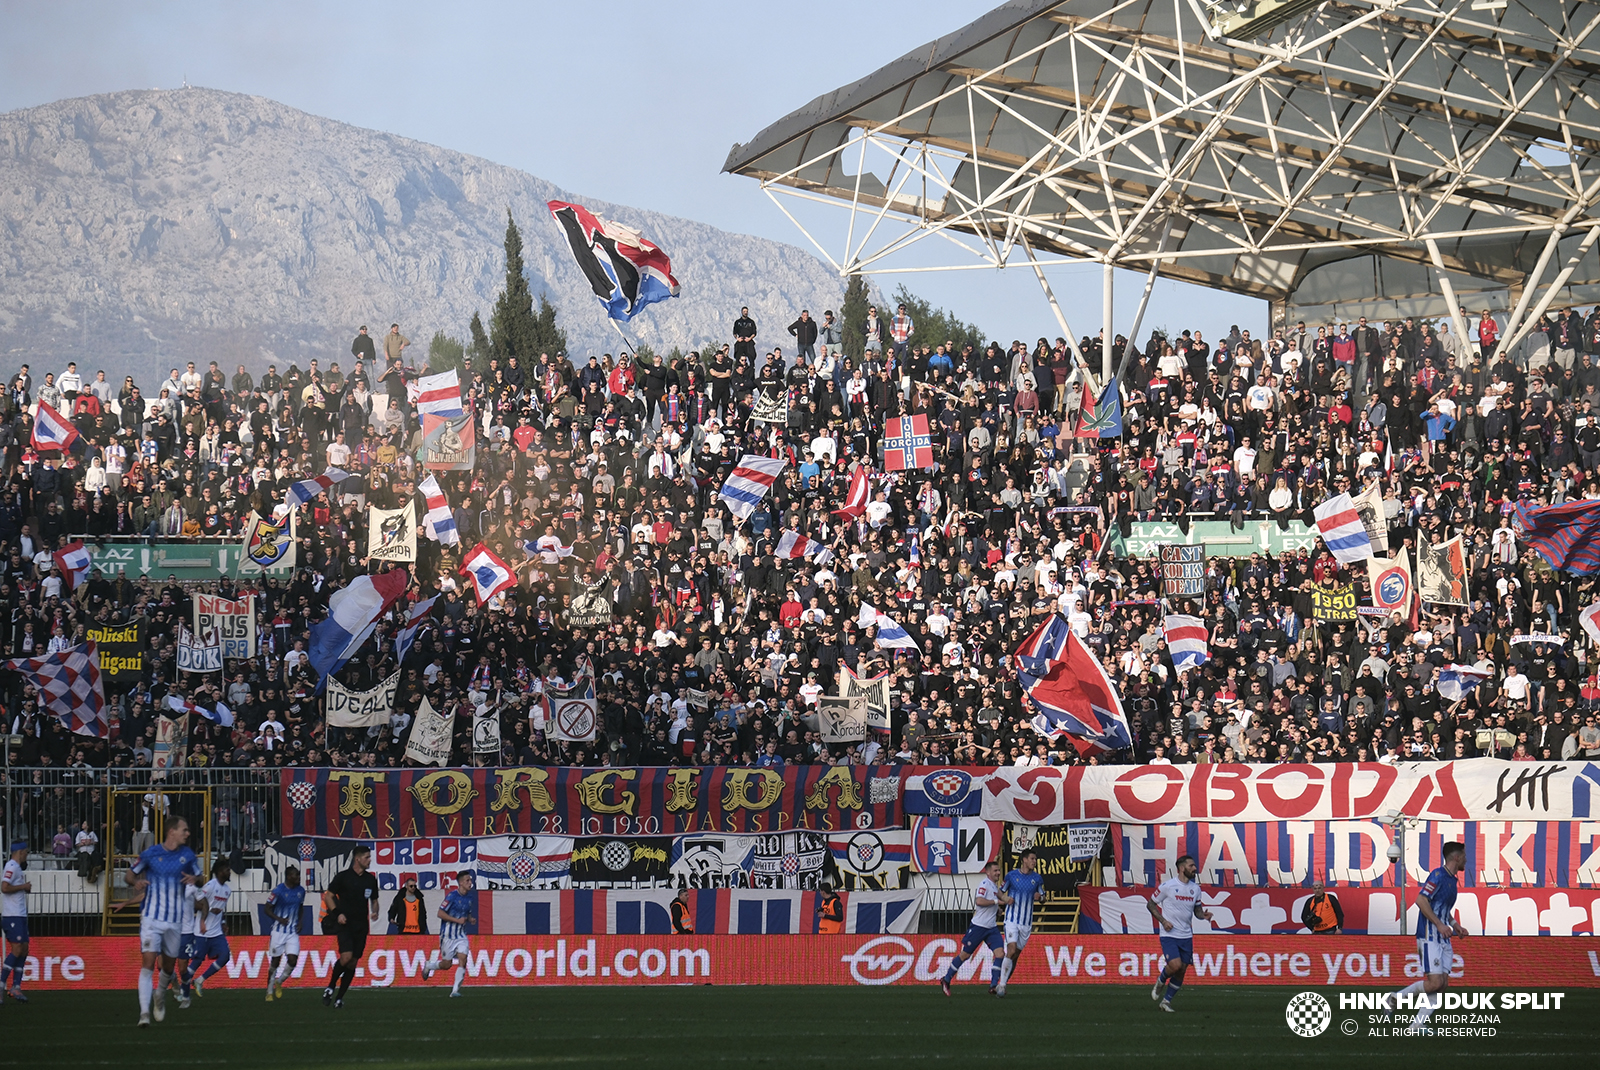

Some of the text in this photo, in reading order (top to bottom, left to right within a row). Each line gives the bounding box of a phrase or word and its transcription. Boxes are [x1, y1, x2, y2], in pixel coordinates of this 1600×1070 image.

[885, 437, 930, 448] TORCIDA
[199, 595, 250, 615] NON
[1311, 591, 1356, 610] 1950
[1312, 607, 1358, 620] ULTRAS
[86, 624, 138, 643] splitski
[178, 646, 222, 669] DUK
[328, 689, 396, 715] IDEALE
[328, 766, 864, 818] TORCIDA
[1013, 762, 1471, 821] SLOBODA
[331, 813, 420, 839] VAŠA
[440, 812, 517, 836] VIRA
[678, 812, 738, 833] VAŠ
[1121, 819, 1538, 887] HAJDUK
[1045, 945, 1113, 977] We
[1193, 945, 1311, 977] where
[1322, 953, 1390, 984] you
